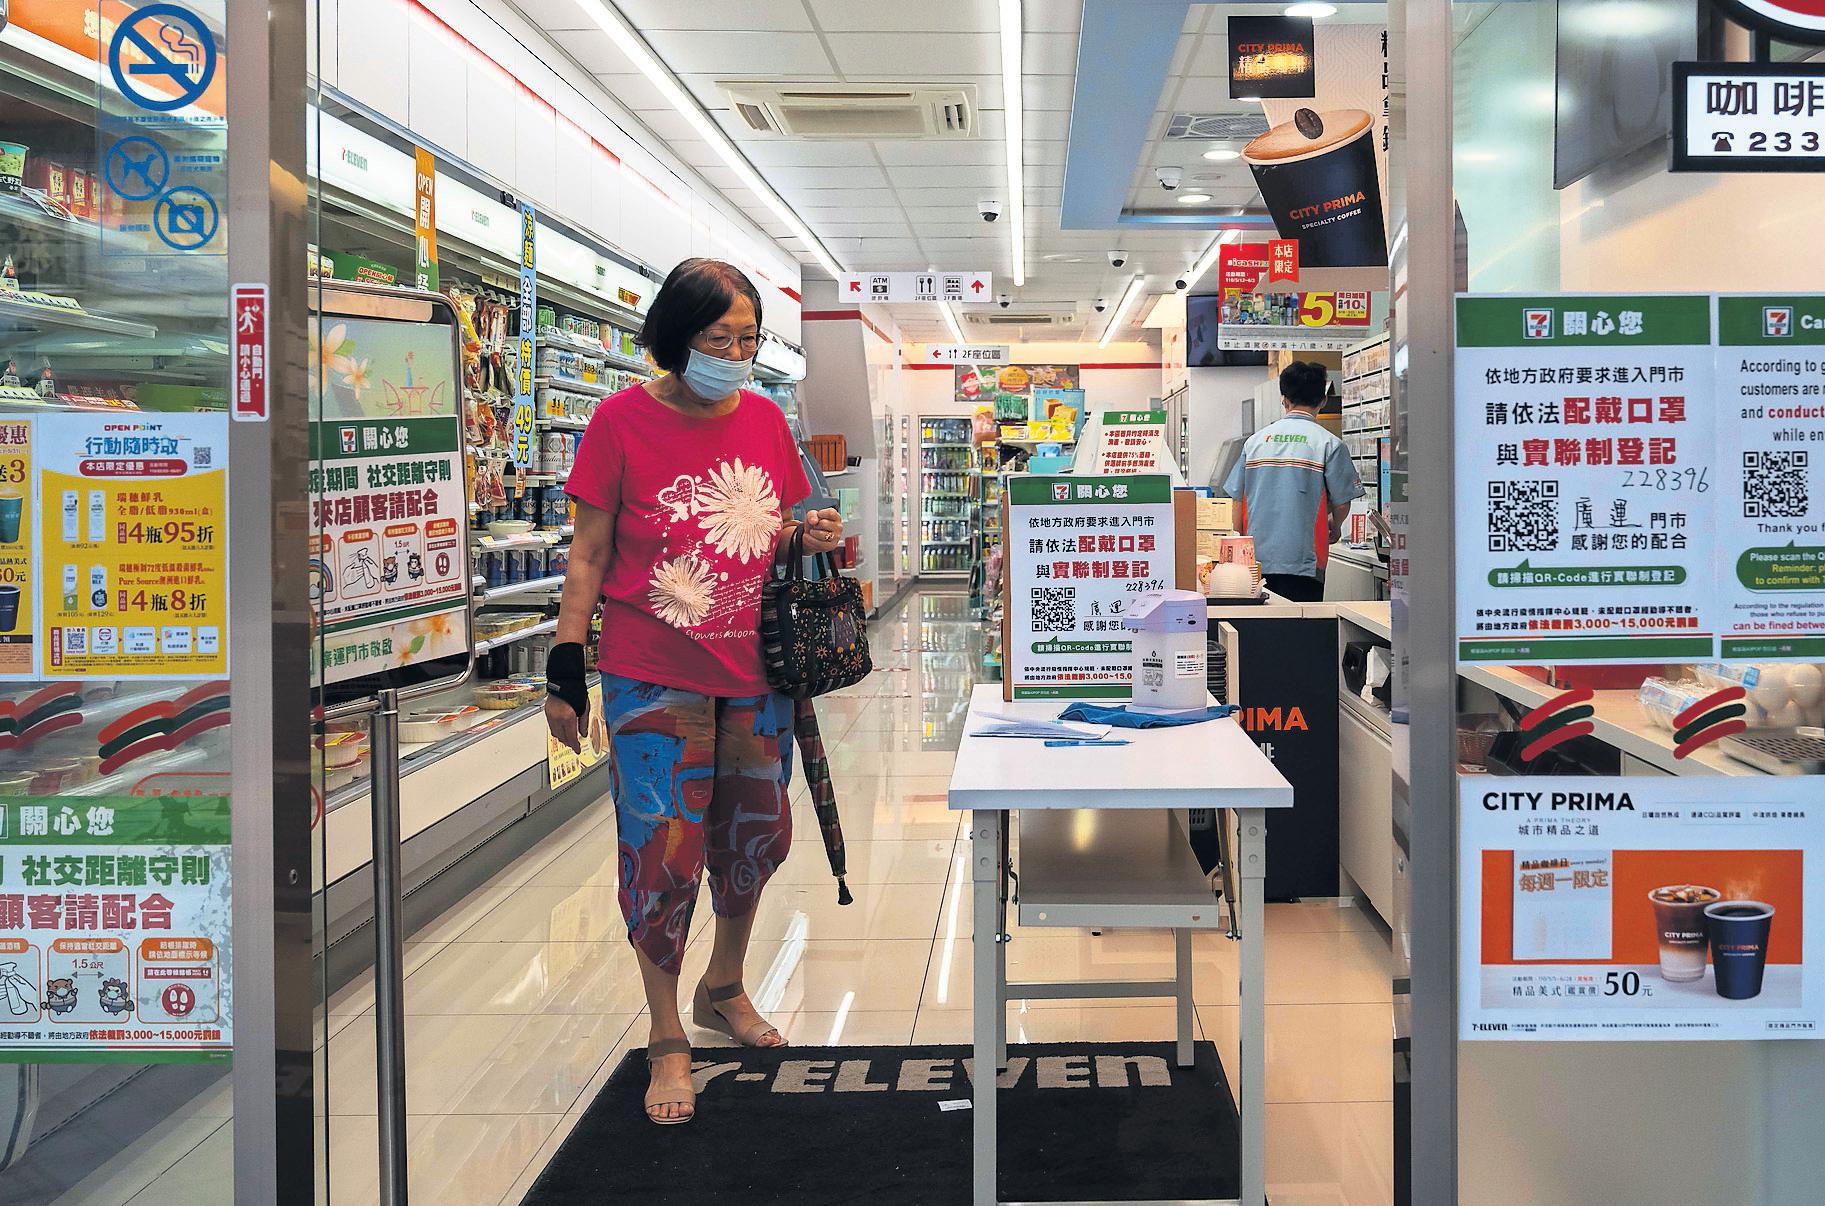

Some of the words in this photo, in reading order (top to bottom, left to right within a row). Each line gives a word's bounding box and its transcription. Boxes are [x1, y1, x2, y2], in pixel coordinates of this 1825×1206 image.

[1707, 80, 1825, 117] 咖啡
[1749, 132, 1819, 152] 233
[417, 172, 434, 197] OPEN
[1290, 204, 1320, 220] CITY
[1322, 191, 1367, 213] PRIMA
[1273, 243, 1293, 258] 本店
[1273, 260, 1293, 274] 限定
[1563, 311, 1644, 336] 關心您
[1485, 366, 1685, 385] 依地方政府要求進入門市
[1740, 359, 1801, 376] According
[1805, 360, 1817, 372] to
[1740, 382, 1799, 396] customers
[1802, 384, 1819, 396] are
[1485, 396, 1687, 425] 請依法配戴口罩
[1741, 405, 1763, 418] and
[1768, 405, 1825, 418] conduct
[1773, 428, 1805, 441] while
[1496, 437, 1677, 467] 與實聯制登記
[1028, 515, 1155, 529] 依地方政府要求進入門市
[1650, 512, 1687, 530] 門市
[1757, 523, 1792, 533] Thank
[1796, 525, 1818, 534] you
[1028, 534, 1156, 554] 請依法配戴口罩
[1571, 532, 1688, 550] 感謝您的配合
[1750, 552, 1778, 561] Please
[1036, 560, 1151, 580] 與實聯制登記
[1733, 622, 1751, 630] can
[1753, 621, 1766, 630] be
[1768, 621, 1793, 630] fined
[1481, 791, 1543, 811] CITY
[1551, 791, 1635, 811] PRIMA
[20, 805, 115, 836] 關心您
[1517, 825, 1600, 837] 城市精品之道
[21, 855, 210, 887] 社交距離守則
[72, 958, 88, 969] 1.5
[1604, 971, 1640, 996] 50
